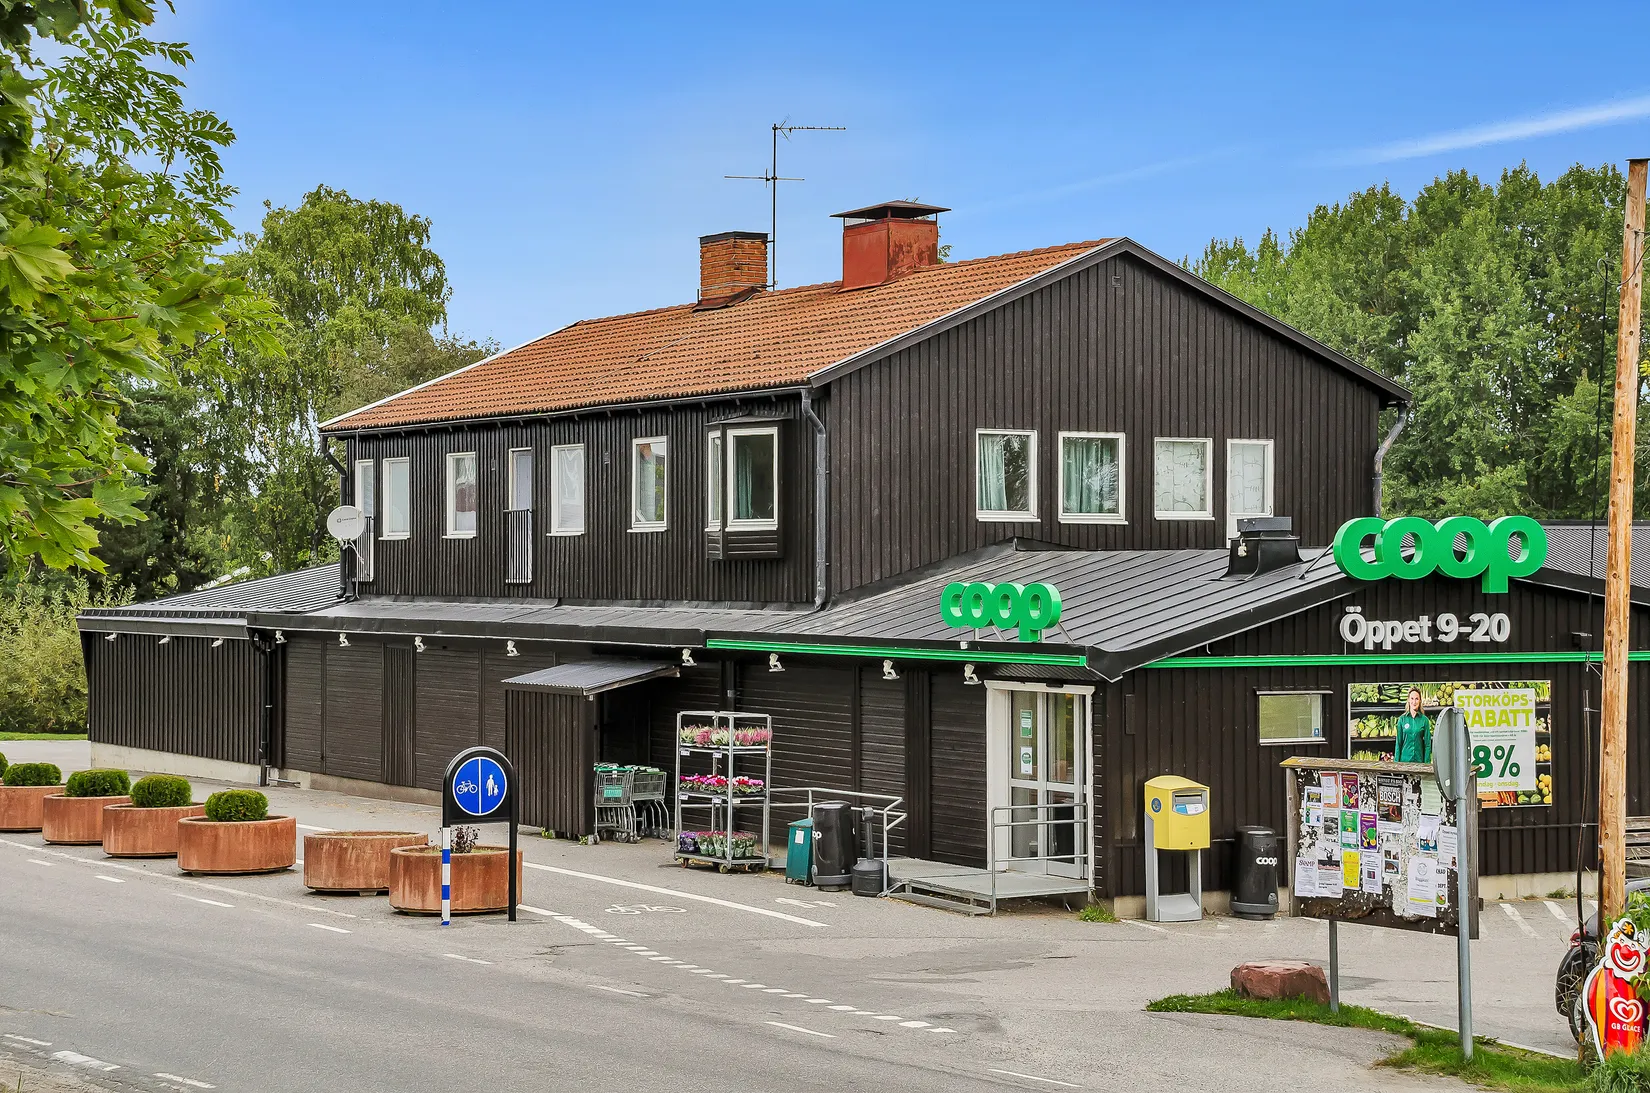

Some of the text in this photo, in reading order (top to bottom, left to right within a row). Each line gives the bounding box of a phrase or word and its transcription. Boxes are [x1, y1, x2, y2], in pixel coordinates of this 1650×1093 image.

[1333, 516, 1548, 593] coop
[940, 582, 1062, 642] coop
[1340, 605, 1511, 650] Öppet 9-20
[1457, 692, 1533, 707] STORKÖPS-
[1471, 745, 1520, 778] 8%
[1380, 791, 1401, 803] BOSCH
[812, 830, 822, 840] op
[1256, 857, 1277, 866] coop
[1611, 1022, 1621, 1030] GB
